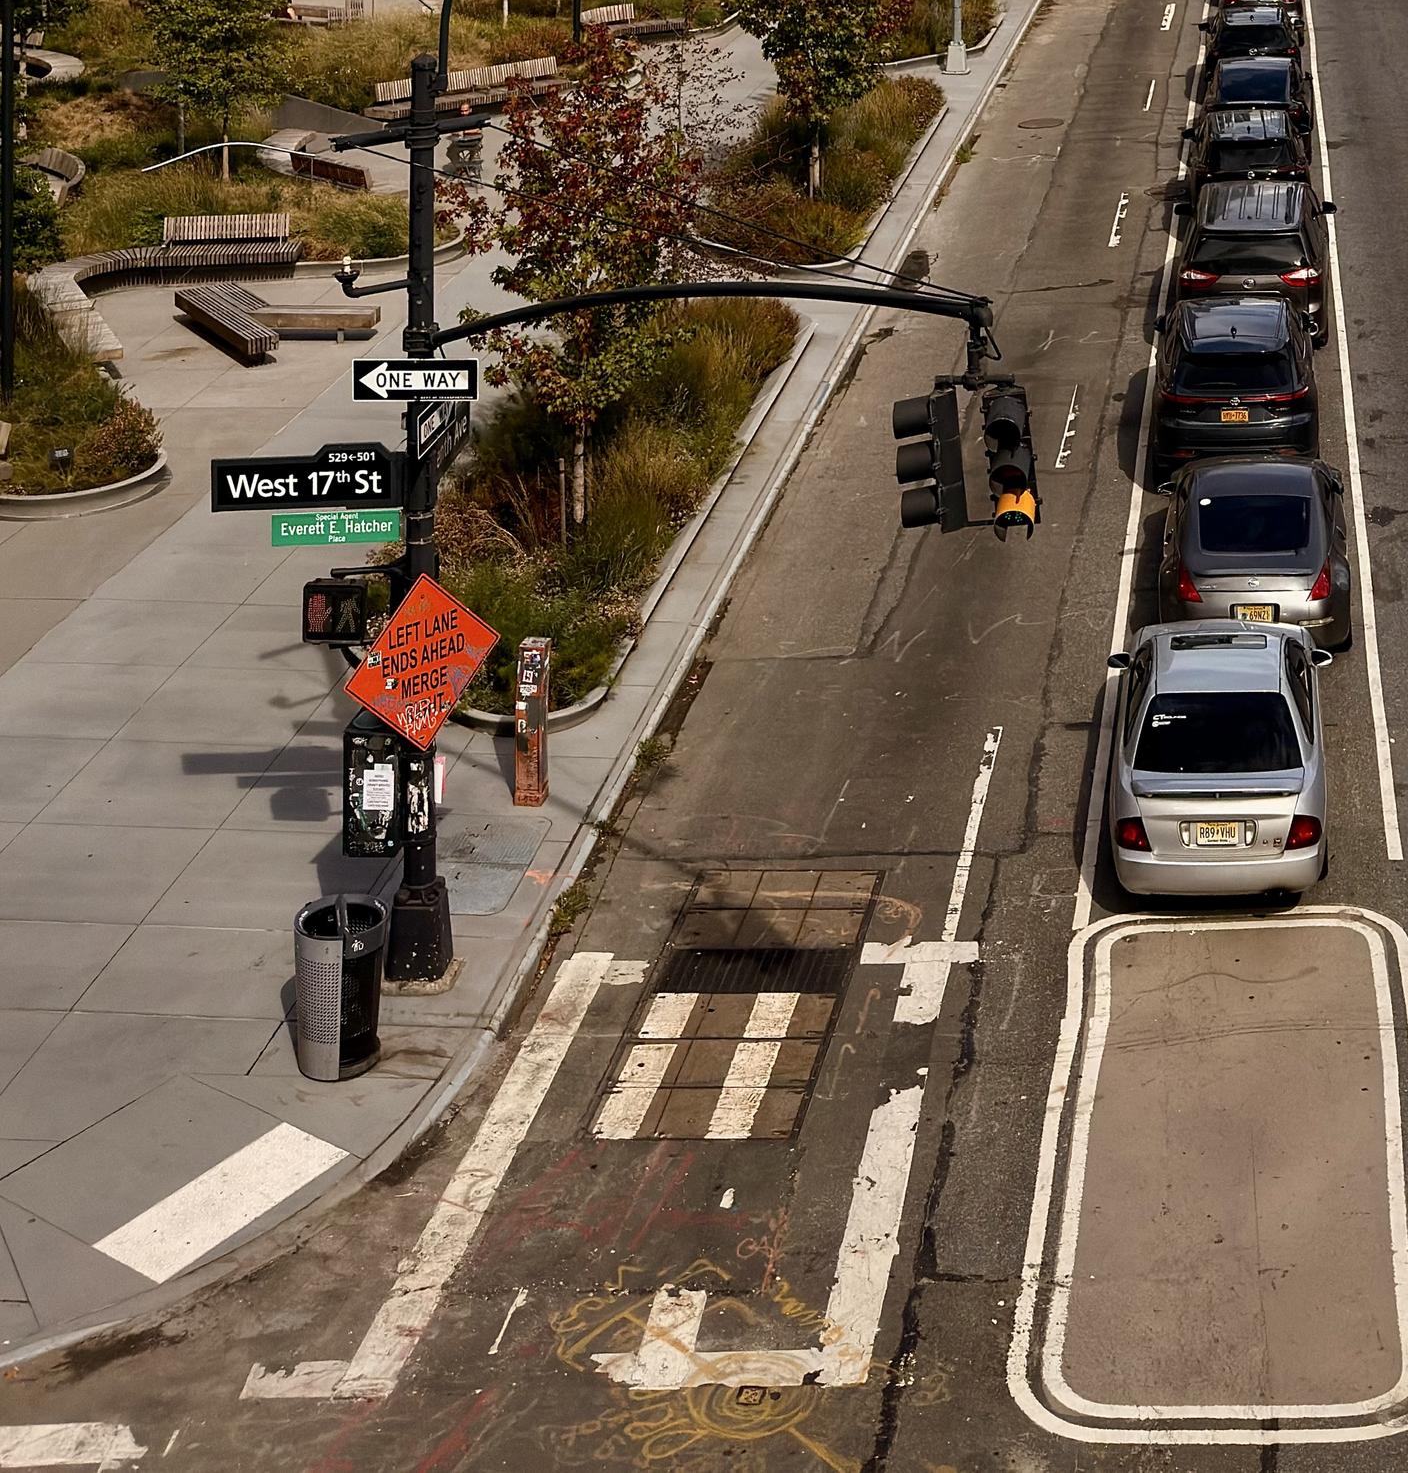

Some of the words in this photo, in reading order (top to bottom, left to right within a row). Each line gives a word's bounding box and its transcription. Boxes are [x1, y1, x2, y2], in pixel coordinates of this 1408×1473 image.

[376, 372, 413, 388] ONE
[423, 372, 460, 388] WAY
[328, 452, 348, 463] 529
[357, 452, 376, 462] 501
[226, 473, 299, 499] West
[307, 470, 350, 496] 17th
[355, 469, 382, 494] St
[315, 513, 339, 521] Special
[340, 512, 359, 521] Agent
[281, 521, 324, 536] Everett
[329, 521, 340, 535] E.
[345, 519, 393, 534] Hatcher
[328, 535, 346, 543] Place
[388, 621, 420, 650] LEFT
[425, 609, 458, 638] LANE
[382, 649, 418, 678] ENDS
[420, 632, 465, 666] AHEAD
[401, 665, 448, 699] MERGE
